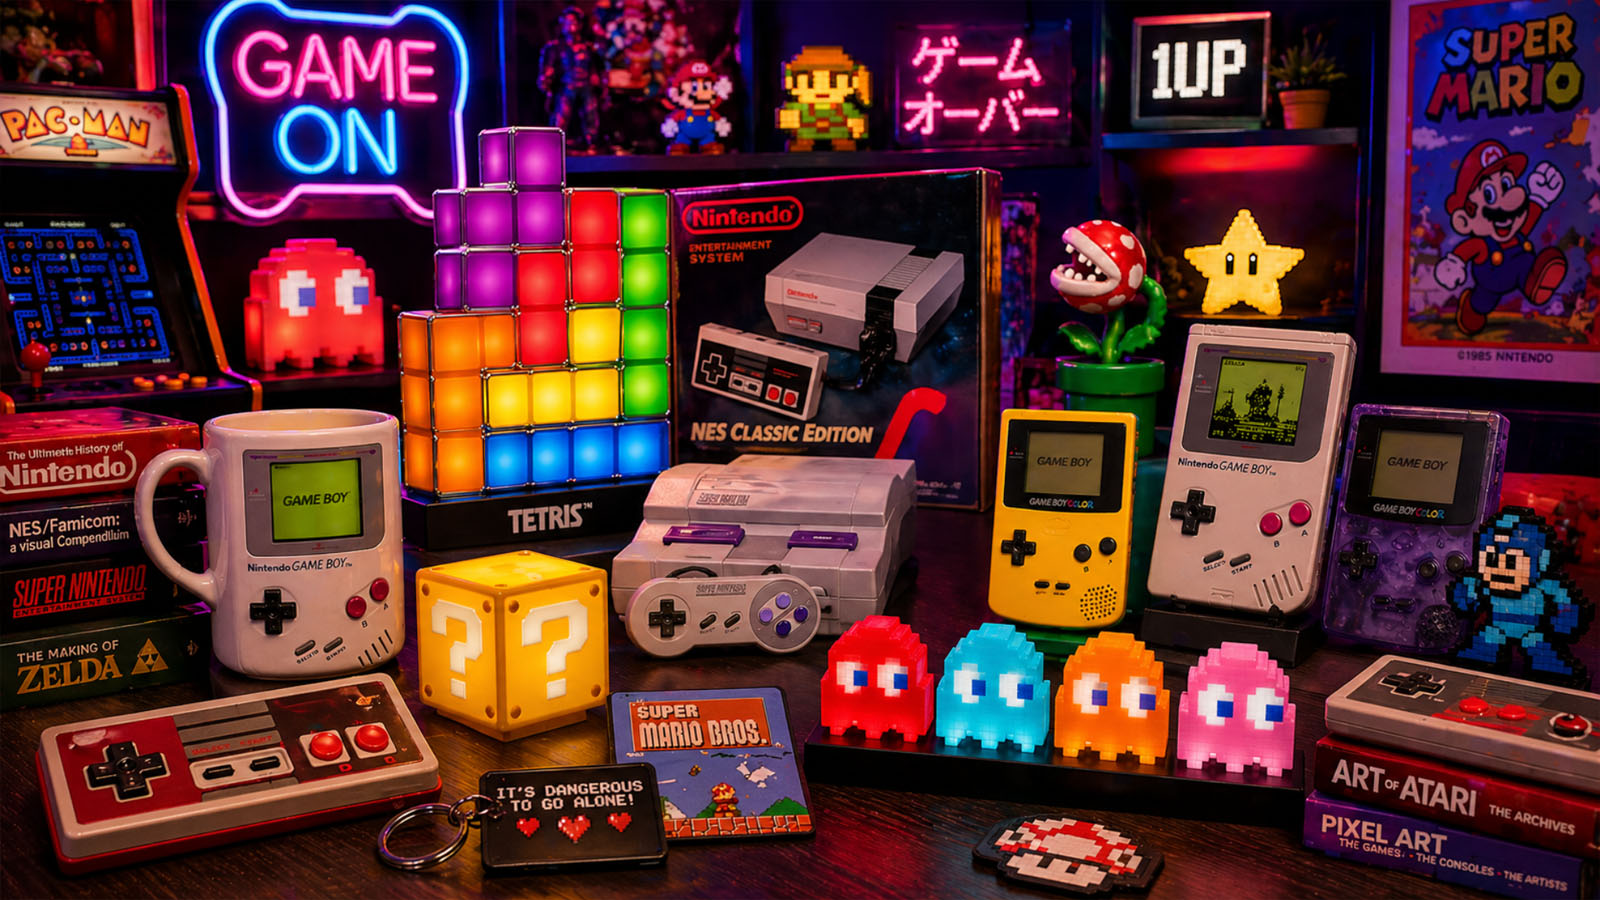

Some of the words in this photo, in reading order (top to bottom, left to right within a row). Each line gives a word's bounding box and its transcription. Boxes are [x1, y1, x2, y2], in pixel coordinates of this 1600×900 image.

[1441, 13, 1577, 69] SUPER
[232, 30, 438, 103] GAME
[911, 35, 1043, 86] ゲーム
[1151, 38, 1248, 99] 1UP
[1425, 60, 1584, 122] MARIO
[902, 90, 1061, 136] オーバー
[273, 104, 398, 175] ON
[692, 204, 793, 228] Nintendo
[688, 240, 772, 253] ENTERTAINMENT
[689, 252, 744, 264] SYSTEM
[690, 422, 727, 442] NES
[730, 422, 800, 442] CLASSIC
[802, 423, 874, 443] EDITION
[6, 450, 26, 461] The
[75, 444, 110, 455] History
[1037, 456, 1069, 467] GAME
[1070, 457, 1092, 467] BOY
[0, 455, 126, 488] Nintendo
[1178, 457, 1218, 470] Nintendo
[1219, 461, 1249, 473] GAME
[1387, 456, 1421, 468] GAME
[1422, 459, 1448, 471] BOY
[282, 494, 321, 507] GAME
[323, 491, 350, 504] BOY
[1029, 497, 1051, 506] GAME
[1052, 498, 1067, 507] BOY
[1373, 503, 1398, 514] GAME
[1398, 505, 1416, 516] BOY
[9, 515, 120, 538] NES/Famicom:
[1301, 529, 1308, 537] A
[9, 543, 17, 554] a
[19, 537, 54, 552] visual
[1273, 540, 1280, 548] B
[247, 563, 291, 573] Nintendo
[291, 559, 323, 572] GAME
[13, 574, 66, 609] SUPER
[361, 620, 368, 628] B
[17, 651, 44, 664] THE
[48, 642, 98, 660] MAKING
[102, 639, 119, 651] OF
[17, 654, 123, 695] ZELDA
[637, 703, 699, 720] SUPER
[639, 720, 703, 748] MARIO
[707, 719, 769, 746] BROS.
[496, 786, 536, 799] IT'S
[544, 780, 644, 797] DANGEROUS
[1331, 759, 1385, 793] ART
[1384, 779, 1399, 791] OF
[1400, 775, 1477, 817] ATARI
[1489, 804, 1511, 820] THE
[1513, 811, 1576, 836] ARCHIVES
[510, 799, 532, 812] TO
[541, 798, 564, 810] GO
[573, 793, 634, 808] ALONE!
[1321, 813, 1389, 844] PIXEL
[1394, 828, 1448, 855] ART
[1338, 837, 1360, 850] THE
[1416, 852, 1437, 865] THE
[1438, 857, 1495, 876] CONSOLES
[1504, 870, 1523, 883] THE
[1524, 874, 1568, 892] ARTISTS
